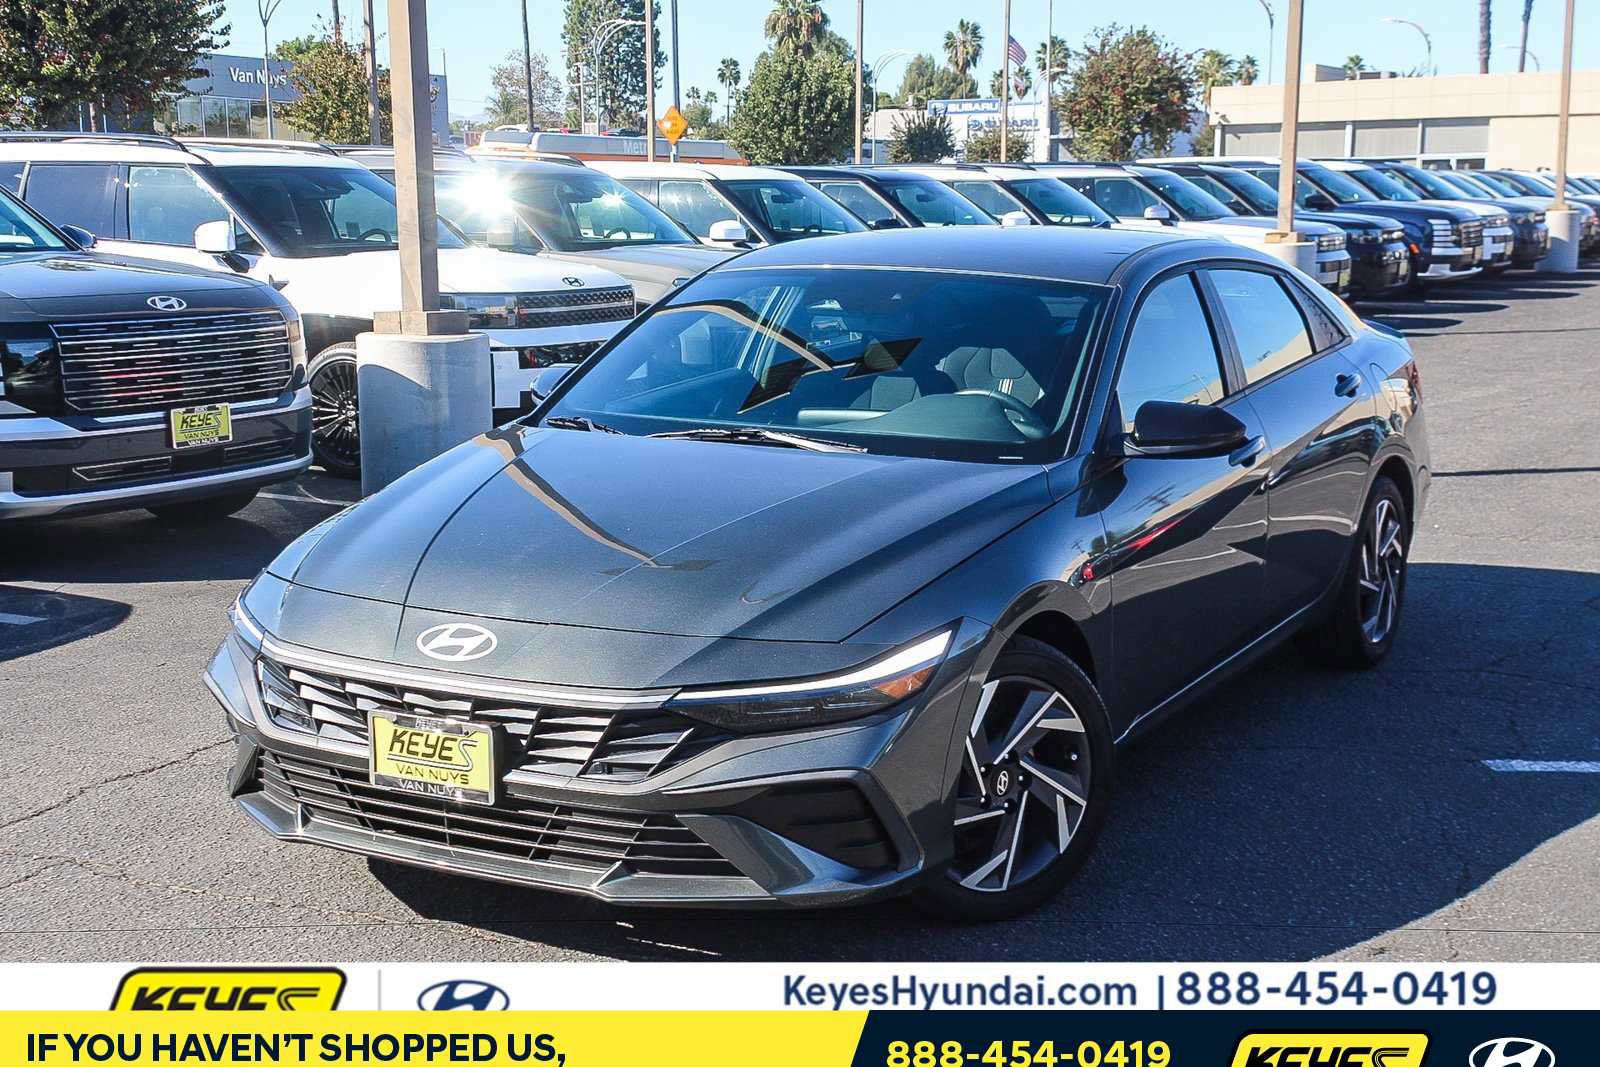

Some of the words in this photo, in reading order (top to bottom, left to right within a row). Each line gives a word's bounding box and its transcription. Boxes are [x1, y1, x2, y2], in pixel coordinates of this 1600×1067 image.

[229, 66, 253, 83] Van
[947, 102, 998, 112] SUBARU
[181, 411, 222, 432] KEYES
[387, 728, 478, 772] KEYES
[396, 763, 424, 778] VAN
[429, 768, 469, 785] NUYS
[399, 779, 425, 792] VAN
